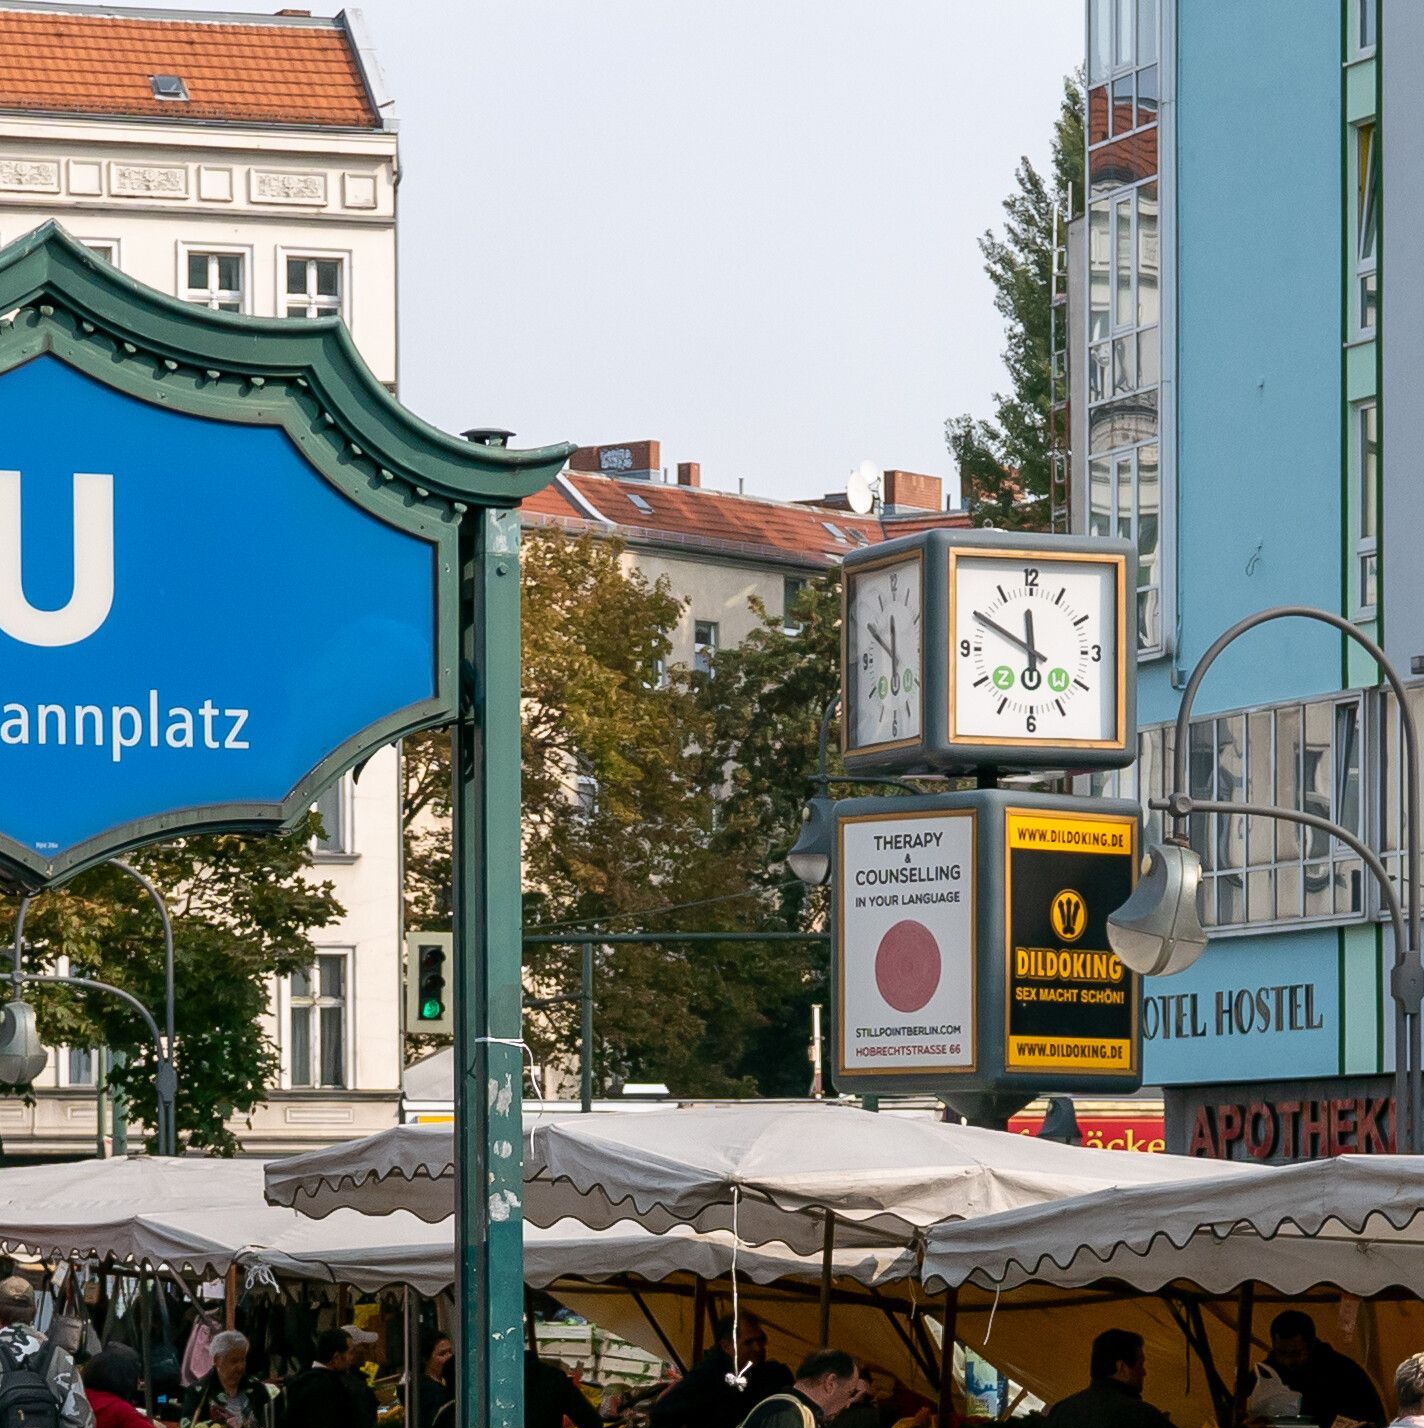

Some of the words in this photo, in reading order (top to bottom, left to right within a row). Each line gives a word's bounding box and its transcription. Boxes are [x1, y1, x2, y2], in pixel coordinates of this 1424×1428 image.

[1025, 567, 1040, 588] 12
[960, 639, 971, 658] 9
[1090, 645, 1102, 663] 3
[1026, 714, 1037, 733] 6
[873, 831, 944, 852] THERAPY
[1017, 826, 1124, 849] WWW.DILDOKING.DE
[904, 853, 912, 864] &
[855, 864, 962, 887] COUNSELLING
[855, 896, 867, 908] IN
[868, 894, 900, 907] YOUR
[901, 891, 962, 906] LANGUAGE
[1015, 948, 1124, 982] DILDOKING
[1015, 988, 1038, 1002] SEX
[1039, 988, 1078, 1003] MACHT
[1080, 987, 1125, 1005] SCHÖN!
[1142, 992, 1208, 1042] OTEL
[1215, 983, 1324, 1036] HOSTEL
[855, 1024, 962, 1038] STILLPOINTBERLIN.COM
[855, 1043, 947, 1058] HOBRECHTSTRASSE
[949, 1043, 962, 1055] 66
[1016, 1042, 1124, 1060] WWW.DILDOKING.DE
[1086, 1128, 1166, 1154] äcke
